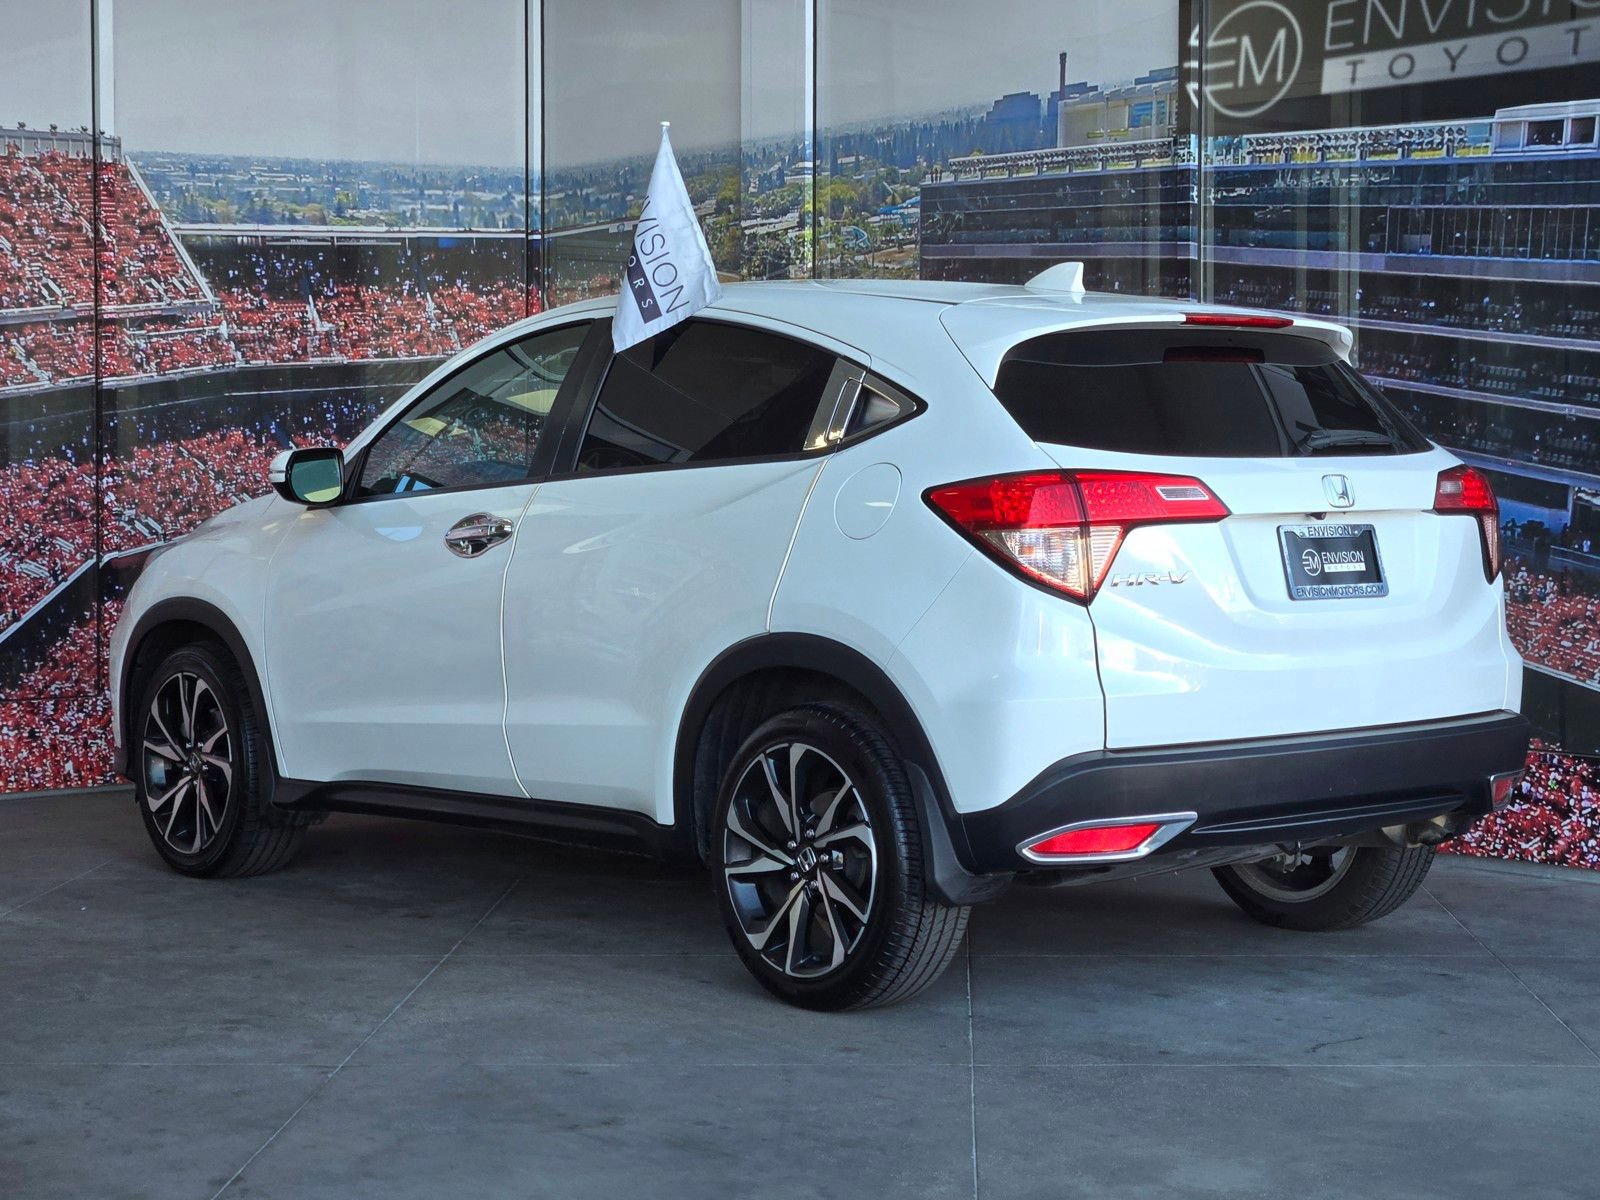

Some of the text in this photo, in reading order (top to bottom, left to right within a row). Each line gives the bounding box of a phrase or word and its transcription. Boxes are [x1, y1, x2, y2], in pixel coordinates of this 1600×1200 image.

[1345, 25, 1591, 85] TOYOT
[637, 195, 690, 314] VISION
[1307, 526, 1352, 537] ENVISION
[1321, 550, 1365, 564] ENVISION
[1296, 585, 1384, 597] ENVISIONMOTORS.COM
